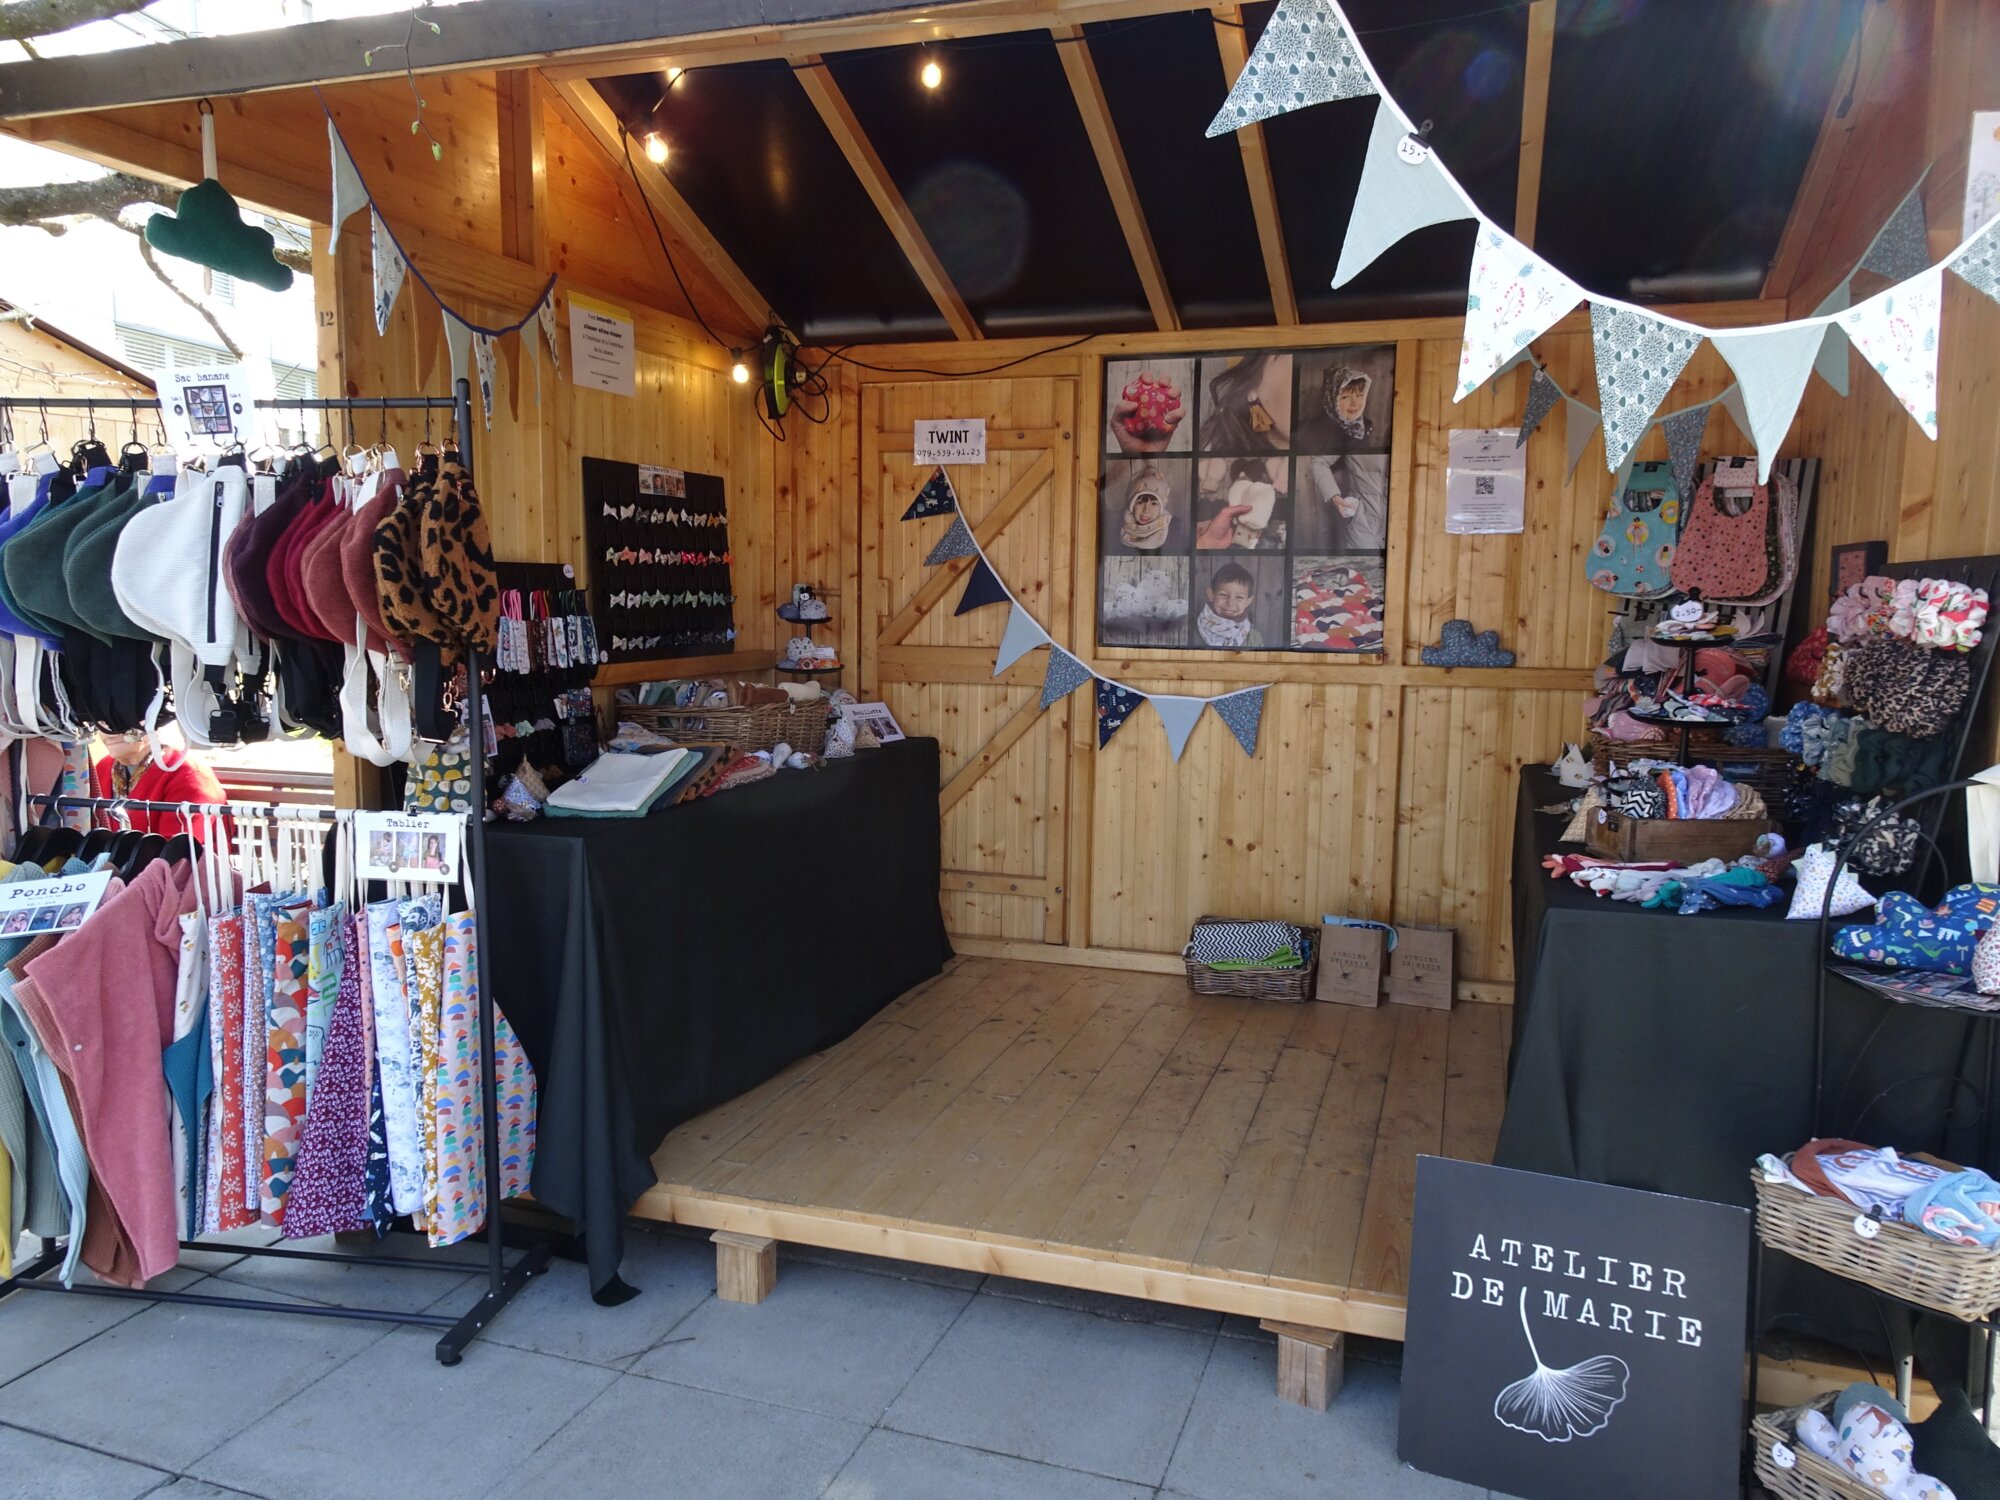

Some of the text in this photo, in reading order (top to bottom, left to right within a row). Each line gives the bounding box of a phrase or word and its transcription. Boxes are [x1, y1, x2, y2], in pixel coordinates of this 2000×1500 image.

[1401, 142, 1428, 156] 15.-
[319, 311, 335, 328] 12
[174, 373, 230, 383] Sac banane
[928, 430, 970, 444] TWINT
[917, 448, 981, 457] 079.539.91.23
[386, 818, 430, 829] Tablier
[8, 883, 86, 899] Poncho
[1468, 1233, 1688, 1299] ATELIER
[1451, 1271, 1702, 1347] DE MARIE
